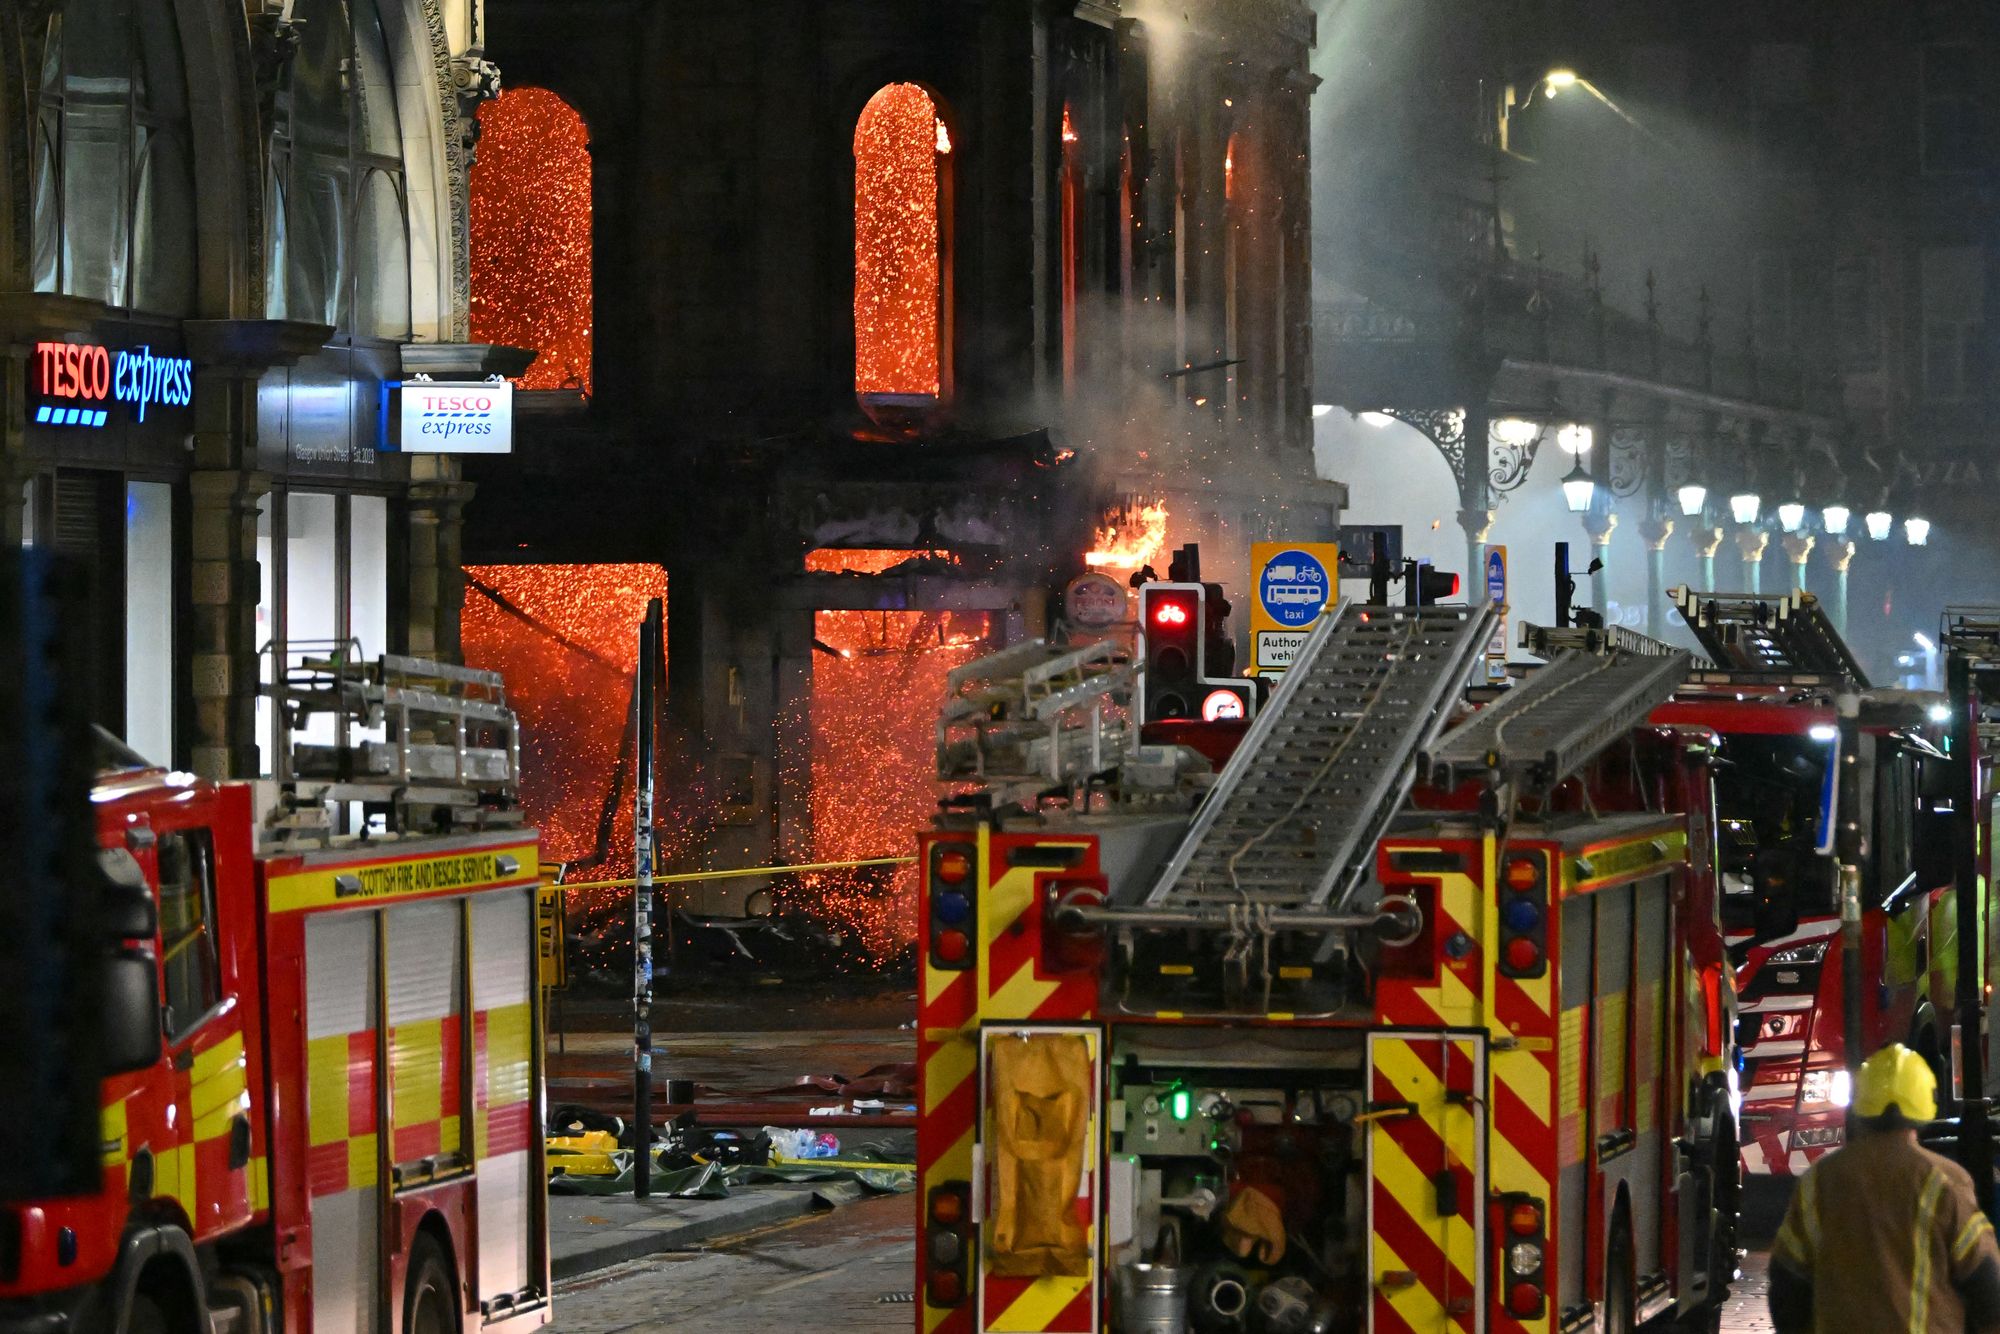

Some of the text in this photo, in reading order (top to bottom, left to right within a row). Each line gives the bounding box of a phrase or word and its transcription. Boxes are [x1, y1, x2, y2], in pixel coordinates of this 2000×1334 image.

[37, 342, 192, 423] TESCO express
[422, 396, 491, 411] TESCO
[422, 420, 491, 439] express
[1284, 609, 1304, 619] taxi
[1263, 637, 1304, 648] Author
[1271, 650, 1294, 661] vehi
[359, 855, 491, 896] SCOTTISH FIRE AND RESCUE SERVICE
